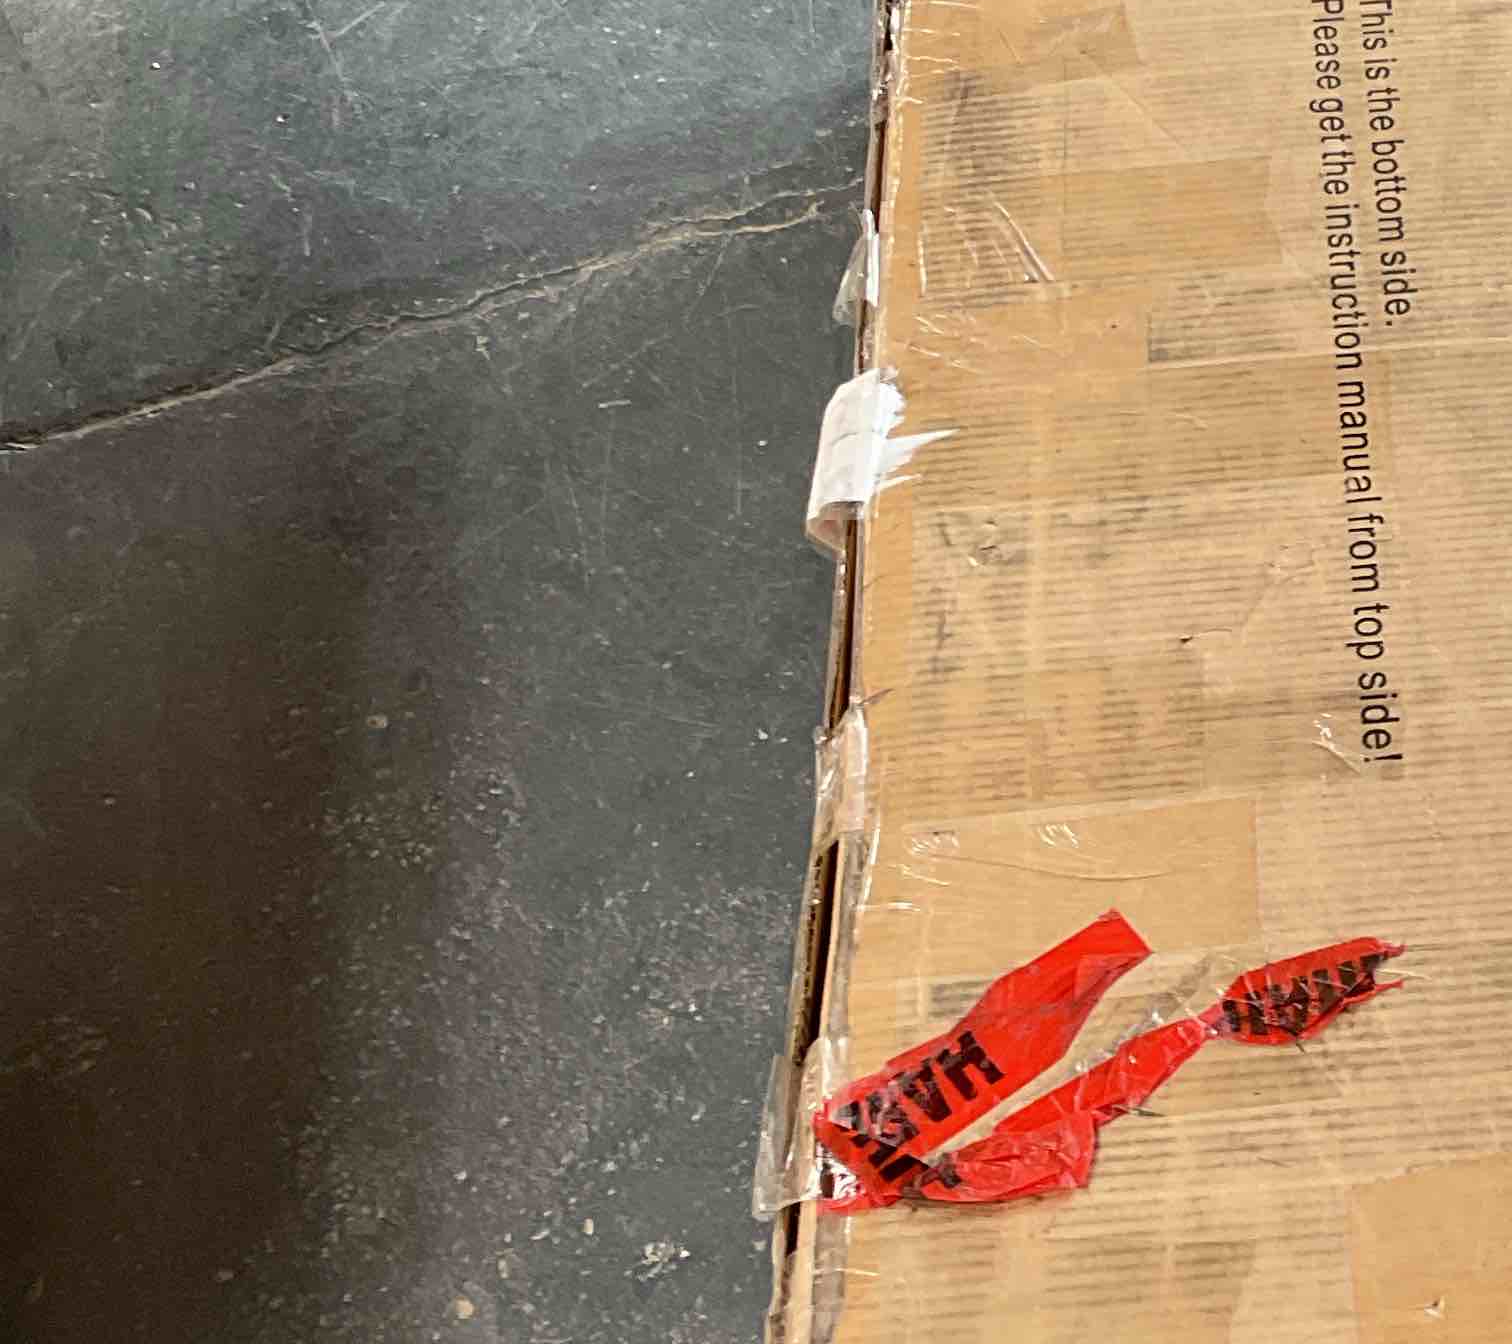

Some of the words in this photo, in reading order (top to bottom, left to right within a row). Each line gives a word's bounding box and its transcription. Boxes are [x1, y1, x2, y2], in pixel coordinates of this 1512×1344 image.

[1363, 58, 1397, 81] is
[1308, 97, 1353, 144] get
[1366, 87, 1401, 132] the
[1321, 150, 1357, 195] the
[1371, 139, 1408, 242] bottom
[1324, 203, 1366, 370] instruction
[1380, 250, 1419, 327] side.
[1336, 380, 1383, 505] manual
[1347, 512, 1385, 593] from
[1345, 602, 1390, 660] top
[1357, 671, 1404, 763] side!
